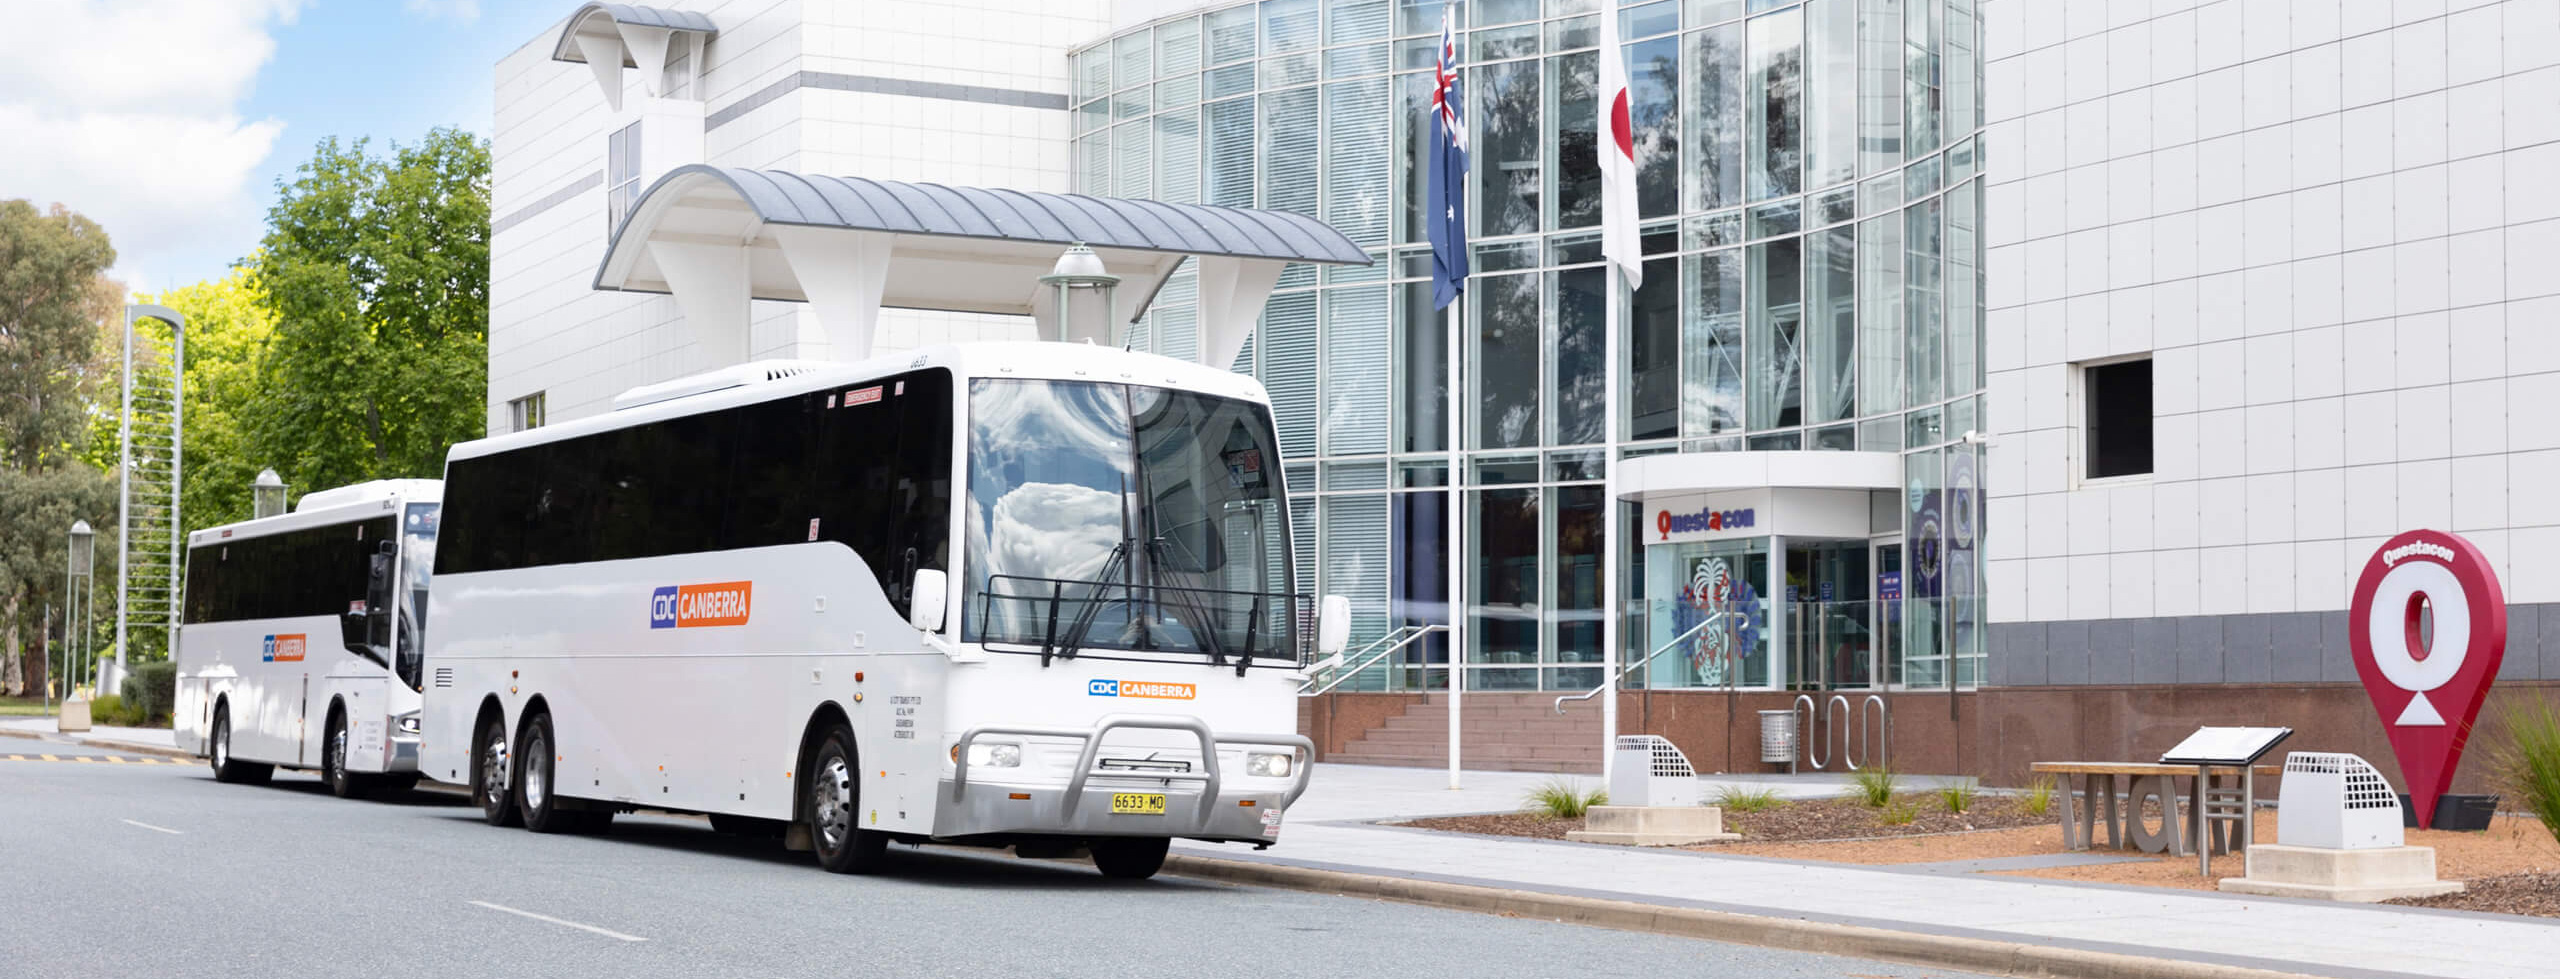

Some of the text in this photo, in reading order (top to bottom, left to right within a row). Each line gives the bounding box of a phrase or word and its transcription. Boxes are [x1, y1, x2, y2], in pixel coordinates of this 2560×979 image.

[1657, 506, 1754, 540] Questacon
[2383, 540, 2455, 567] Questacon
[652, 589, 747, 620] CDC CANBERRA
[275, 639, 304, 656] CANBERRA
[1090, 681, 1193, 698] CDC CANBERRA
